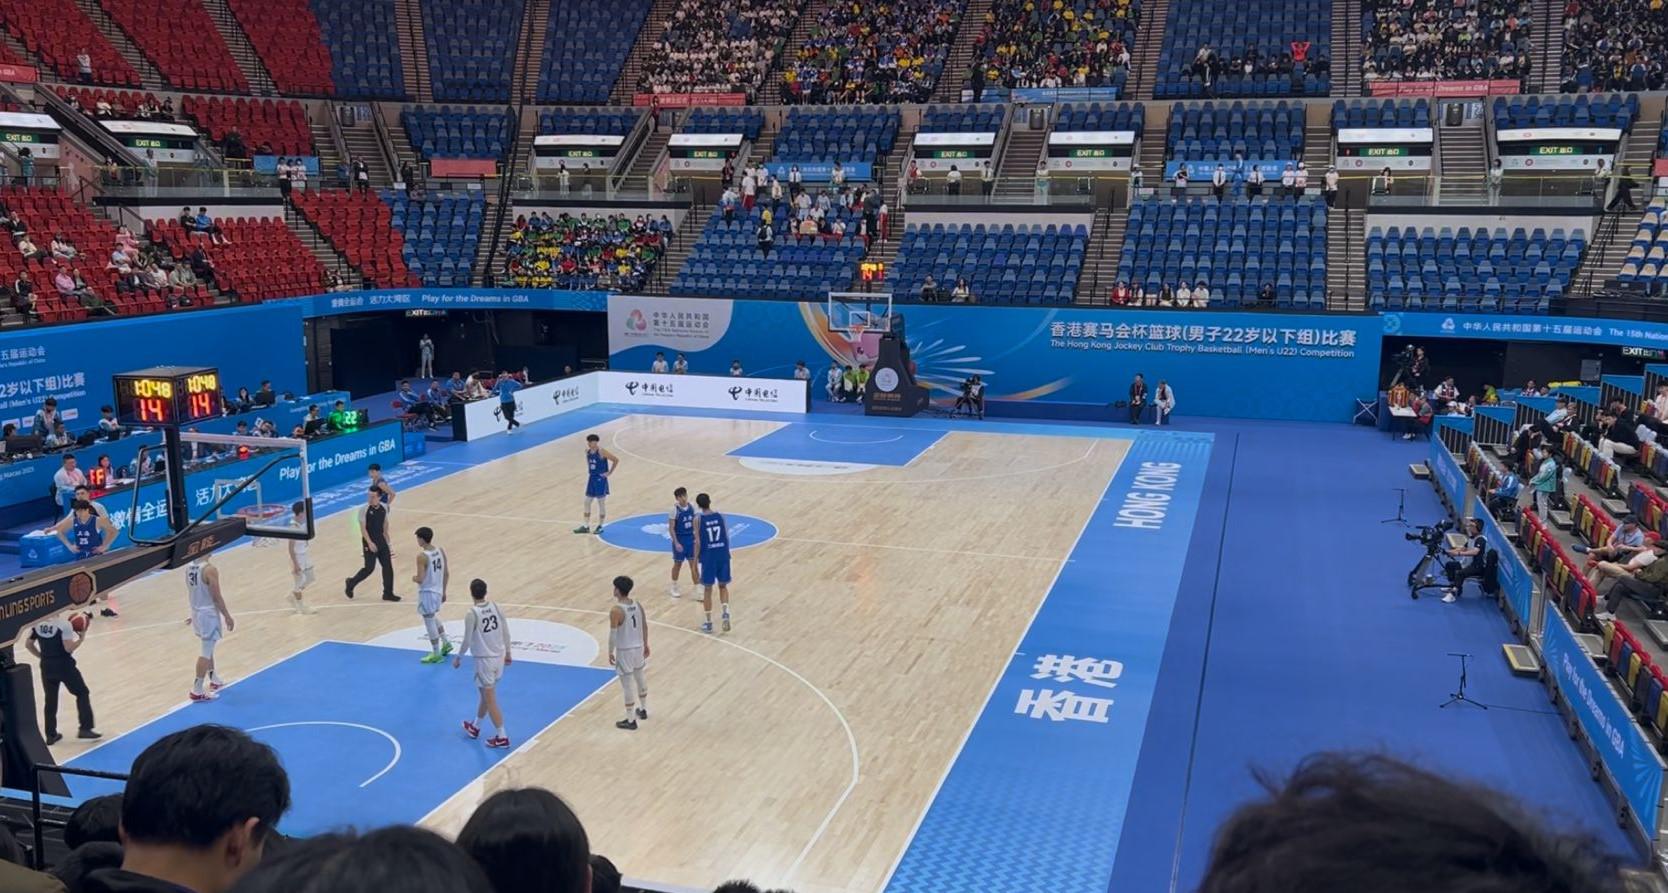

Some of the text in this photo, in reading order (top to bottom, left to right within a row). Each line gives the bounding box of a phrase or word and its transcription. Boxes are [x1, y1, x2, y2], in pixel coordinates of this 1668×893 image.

[136, 139, 149, 147] EXIT
[421, 294, 529, 304] Play for the Dreams in GBA
[652, 311, 710, 321] 中华人民共和国
[652, 319, 710, 329] 第十五届运动会
[1462, 321, 1603, 336] 中华人民共和国第十五届运动会
[1050, 321, 1357, 347] 香港赛马会杯篮球(男子22岁以下组)比赛
[1608, 328, 1624, 337] The
[1626, 329, 1644, 338] 15th
[1, 346, 46, 361] 五届运动会
[1050, 339, 1355, 358] The Hong Kong Jockey Club Trophy Basketball (Men's U22) Competition
[1622, 346, 1643, 356] EXIT
[642, 381, 674, 395] 中国电信
[745, 385, 778, 400] 中国电信
[140, 398, 163, 421] 14
[192, 393, 211, 418] 14
[344, 411, 357, 424] 22
[279, 467, 301, 481] Play
[318, 457, 334, 470] the
[335, 448, 368, 466] Dreams
[369, 444, 377, 456] in
[378, 438, 396, 453] GBA
[1112, 461, 1182, 529] HONG KONG
[706, 526, 720, 542] 17
[432, 558, 442, 573] 14
[189, 571, 198, 586] 31
[482, 614, 498, 633] 23
[631, 614, 637, 628] 1
[1014, 654, 1124, 723] 香港
[1562, 651, 1574, 681] Play
[1586, 688, 1607, 729] Dreams
[1610, 727, 1625, 759] GBA
